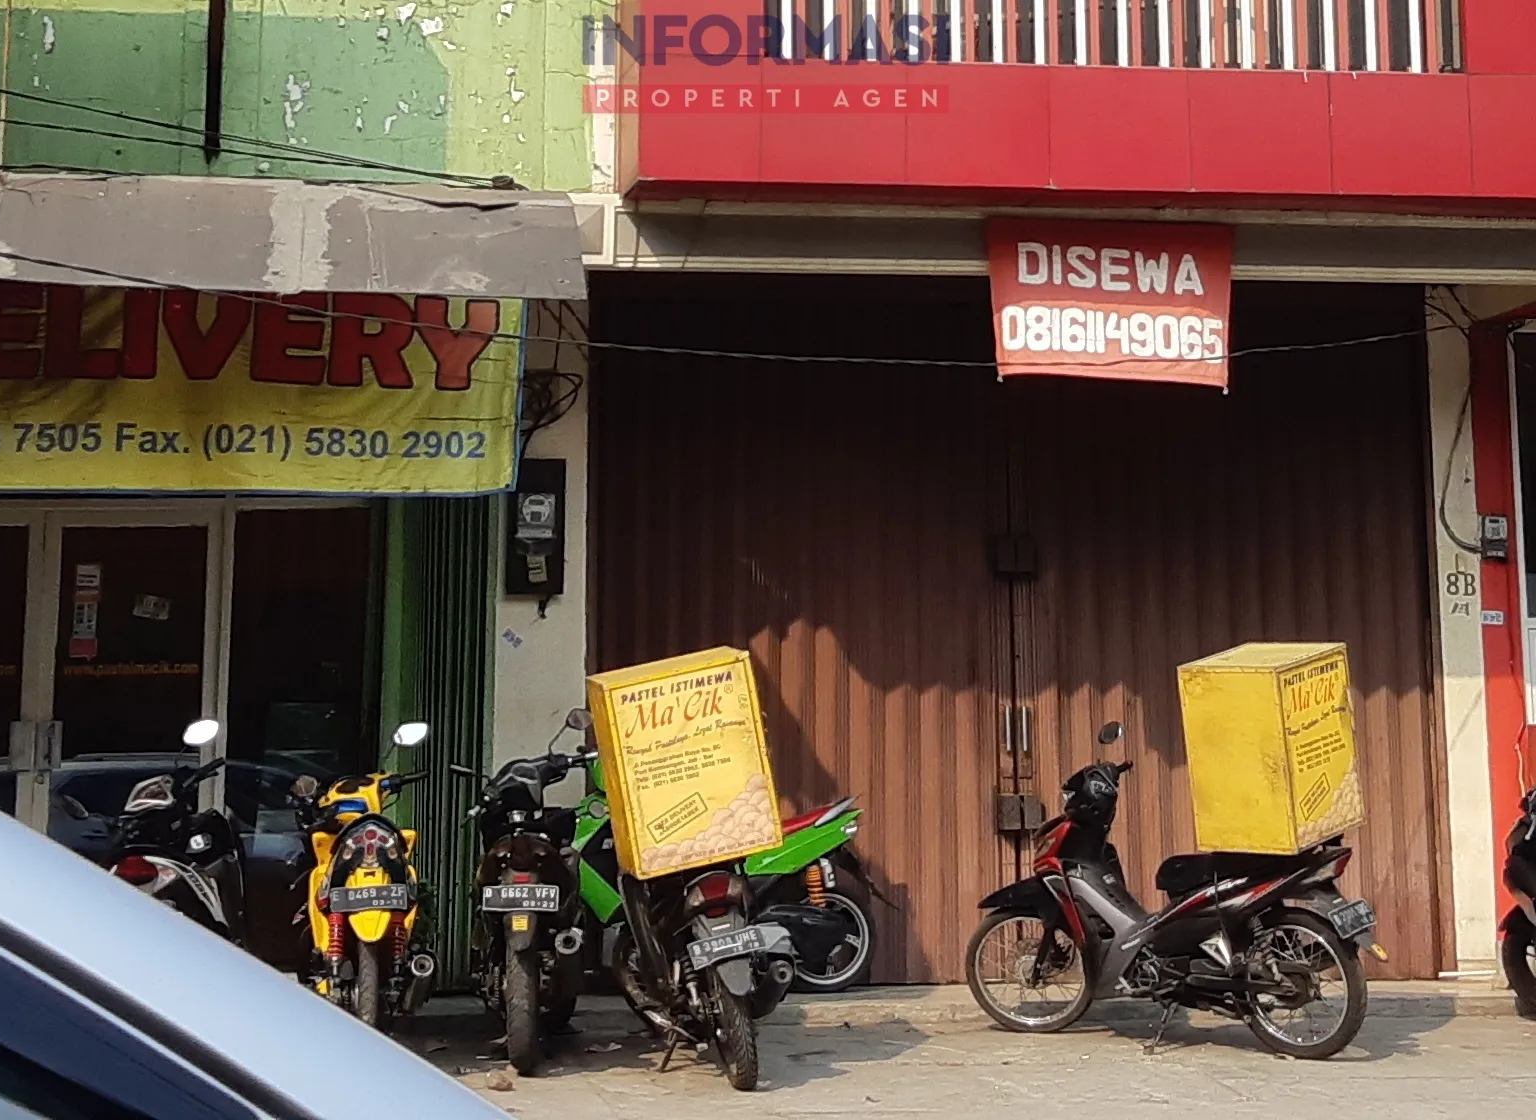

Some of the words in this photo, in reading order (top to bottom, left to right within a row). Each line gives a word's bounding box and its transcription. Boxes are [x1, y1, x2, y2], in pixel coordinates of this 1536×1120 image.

[1016, 241, 1205, 296] DISEWA
[1000, 304, 1224, 365] 08161149065
[13, 422, 102, 454] 7505
[114, 423, 190, 455] Fax.
[202, 423, 293, 462] (021)
[304, 427, 390, 460] 5830
[401, 430, 487, 461] 2902
[620, 686, 666, 706] PASTEL
[670, 670, 733, 694] ISTIMEWA
